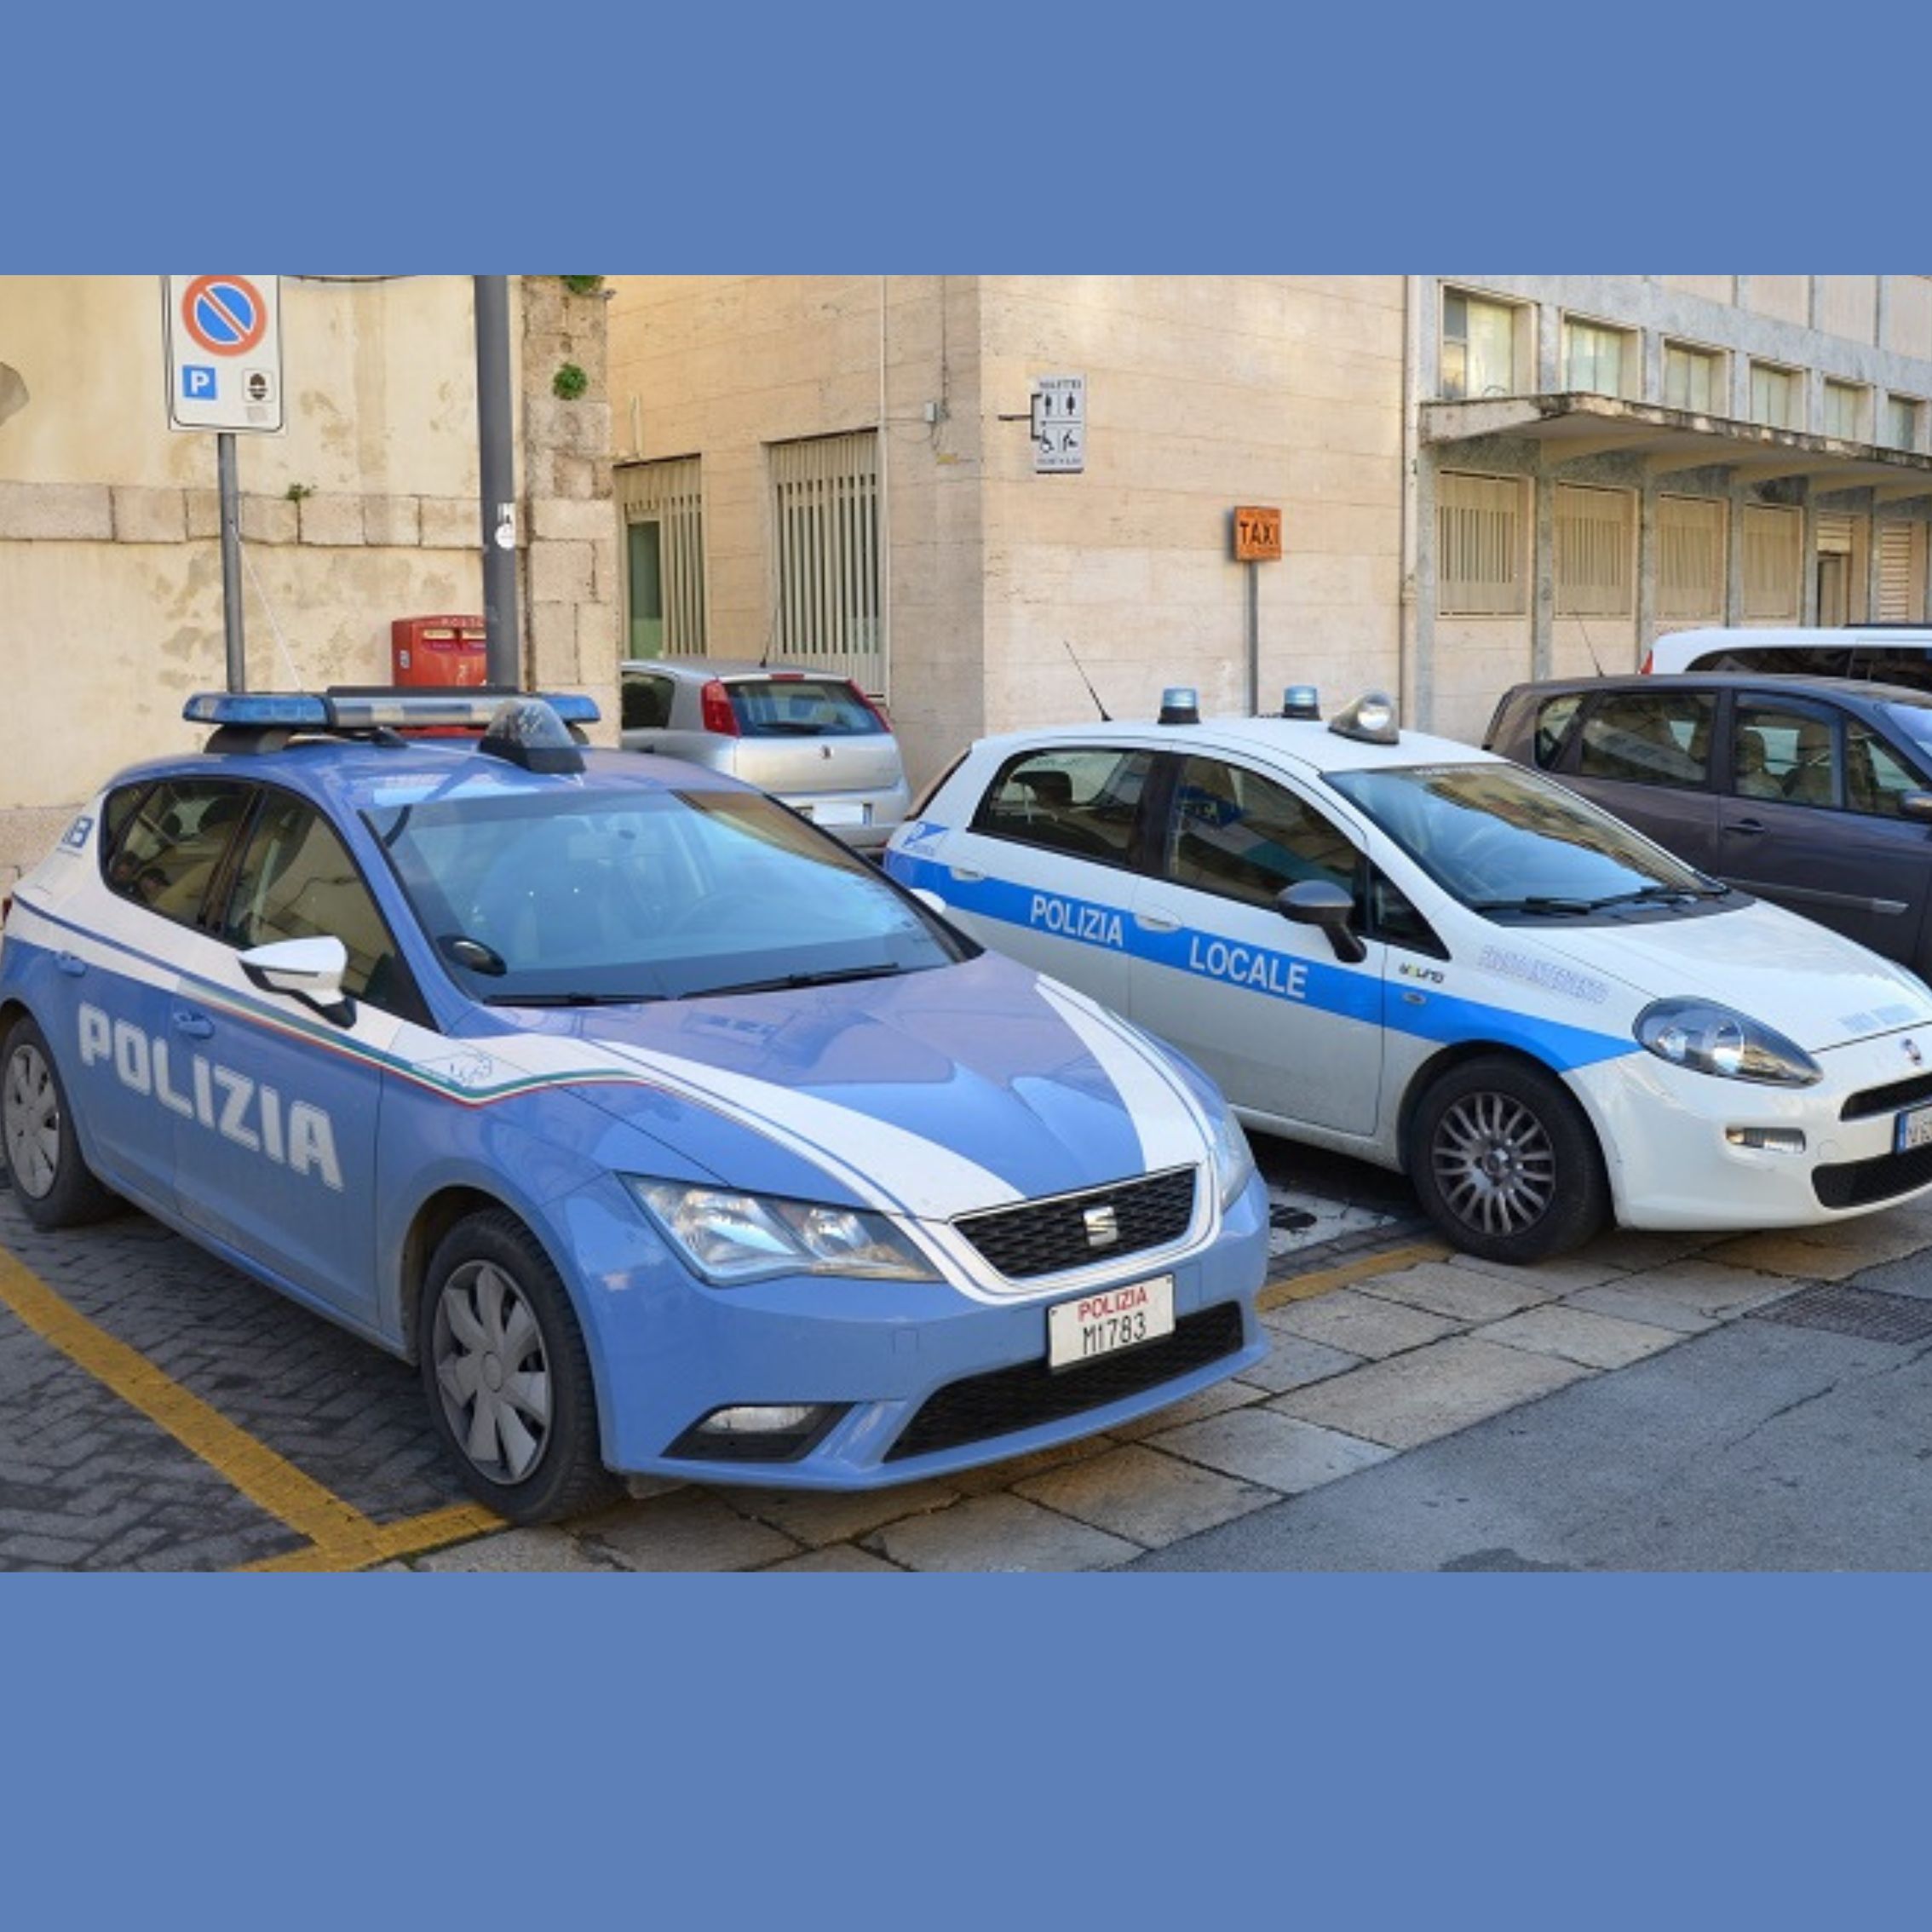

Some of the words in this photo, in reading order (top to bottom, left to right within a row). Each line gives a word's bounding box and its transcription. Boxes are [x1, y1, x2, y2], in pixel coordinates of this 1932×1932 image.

[1239, 521, 1279, 545] TAXI
[1030, 894, 1124, 947] POLIZIA
[1190, 936, 1308, 998] LOCALE
[78, 1002, 342, 1192] POLIZIA
[1078, 1286, 1147, 1322] POLIZIA
